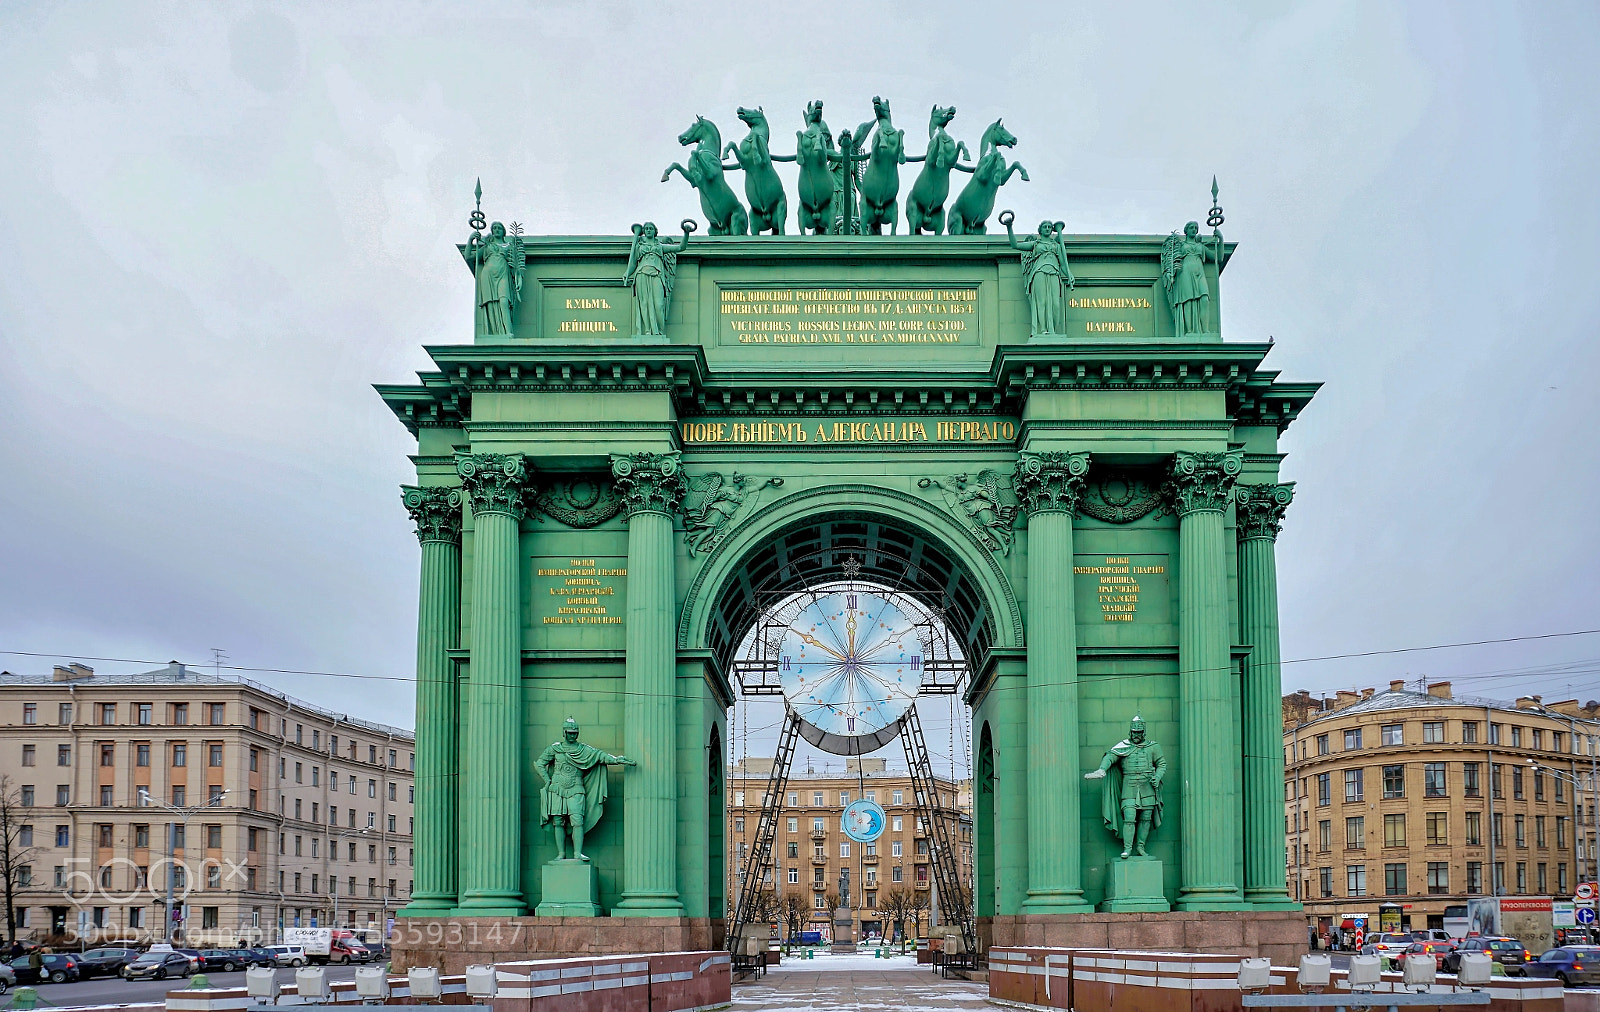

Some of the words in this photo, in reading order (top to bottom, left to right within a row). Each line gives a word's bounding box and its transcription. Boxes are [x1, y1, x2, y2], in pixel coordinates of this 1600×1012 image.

[803, 303, 861, 315] ОТЕЧЕСТВО
[730, 320, 792, 332] VICTRICIBUS
[797, 320, 841, 332] ROSSICIS
[814, 421, 929, 442] АЛЕКСАНДРА
[846, 595, 858, 609] XII
[782, 656, 792, 671] IX
[910, 655, 921, 671] III
[847, 717, 855, 732] VI
